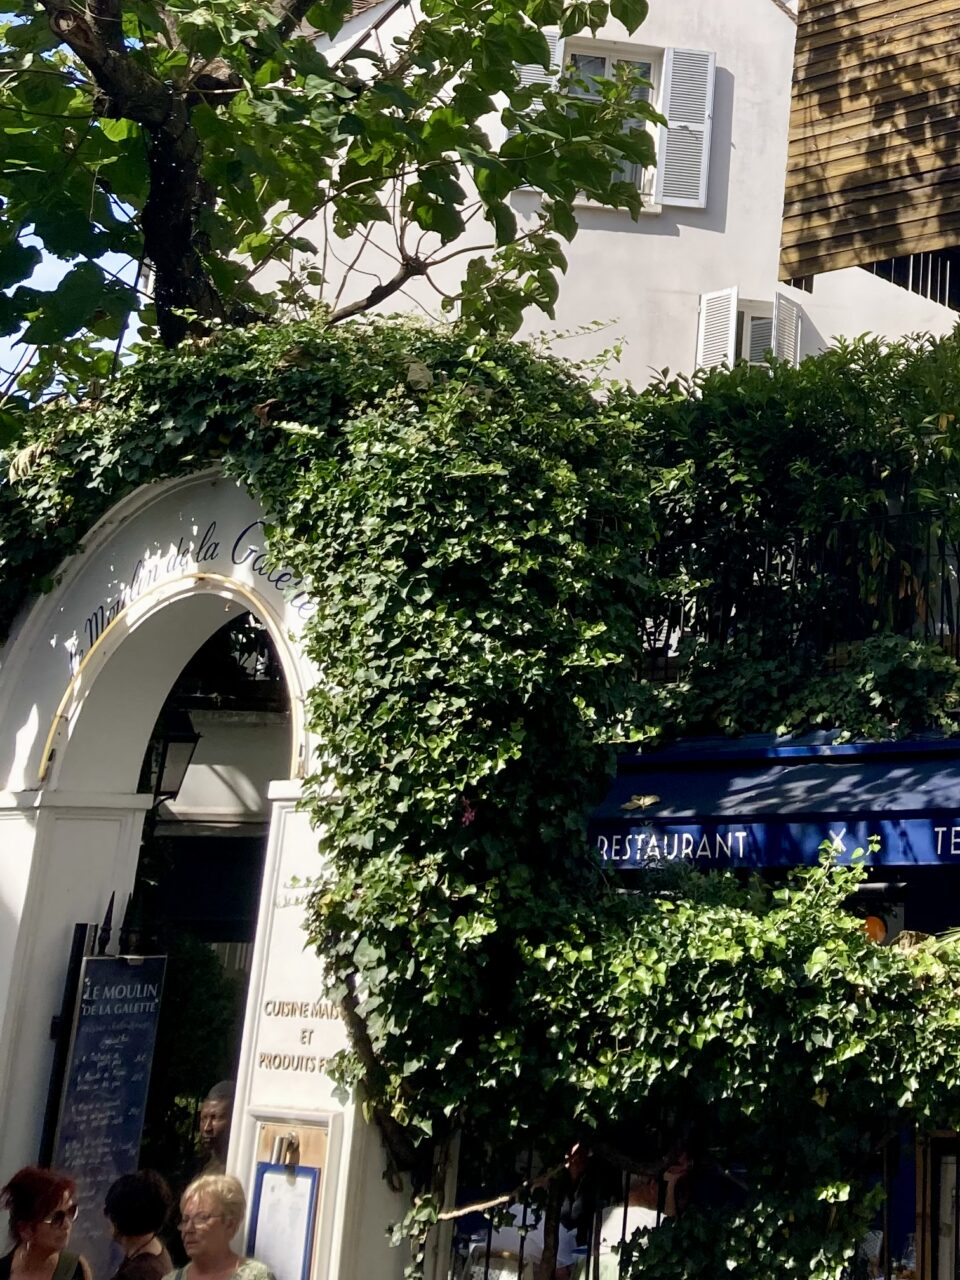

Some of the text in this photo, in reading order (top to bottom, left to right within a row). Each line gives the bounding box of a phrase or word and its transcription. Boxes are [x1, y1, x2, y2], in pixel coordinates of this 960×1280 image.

[196, 521, 220, 563] la
[597, 831, 747, 860] RESTAURANT
[83, 984, 158, 1000] LE MOULIN
[83, 1002, 156, 1016] DE LA GALETTE
[264, 1000, 341, 1020] CUISINE MAIS
[301, 1028, 315, 1045] ET
[259, 1052, 316, 1073] PRODUITS
